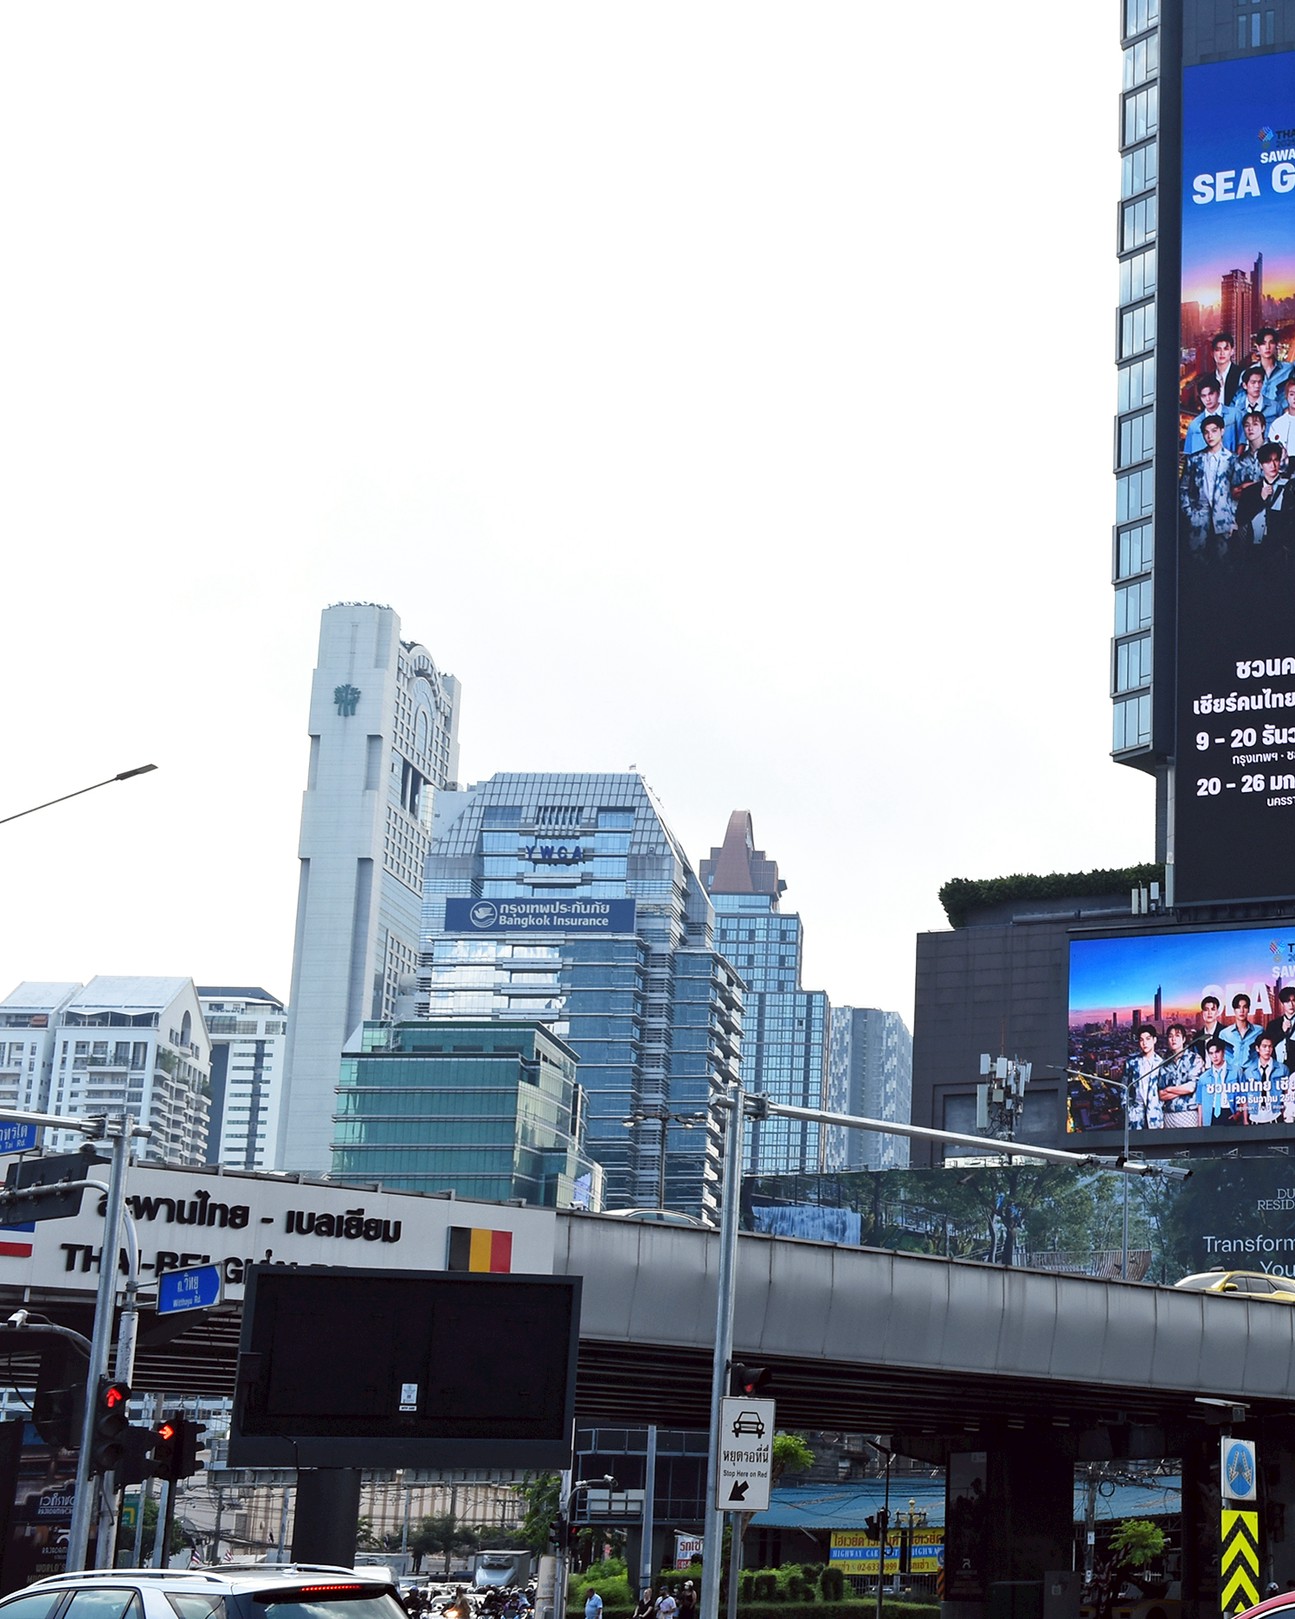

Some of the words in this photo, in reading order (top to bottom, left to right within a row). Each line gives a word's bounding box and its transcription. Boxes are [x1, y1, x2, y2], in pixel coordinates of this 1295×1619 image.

[1192, 167, 1260, 205] SEA
[1196, 732, 1209, 751] 9
[1230, 728, 1257, 748] 20
[1197, 777, 1221, 797] 20
[1241, 774, 1265, 793] 26
[526, 845, 583, 860] YWCA
[500, 901, 610, 917] กรุงเทพประกันภัย
[499, 915, 550, 928] Bangkok
[553, 915, 609, 926] Insurance
[286, 1208, 402, 1243] เบลเยียม
[723, 1444, 769, 1466] หยุดรอที่นี่
[723, 1470, 736, 1478] Stop
[736, 1470, 749, 1478] Here
[832, 1548, 863, 1558] HIGHWAY
